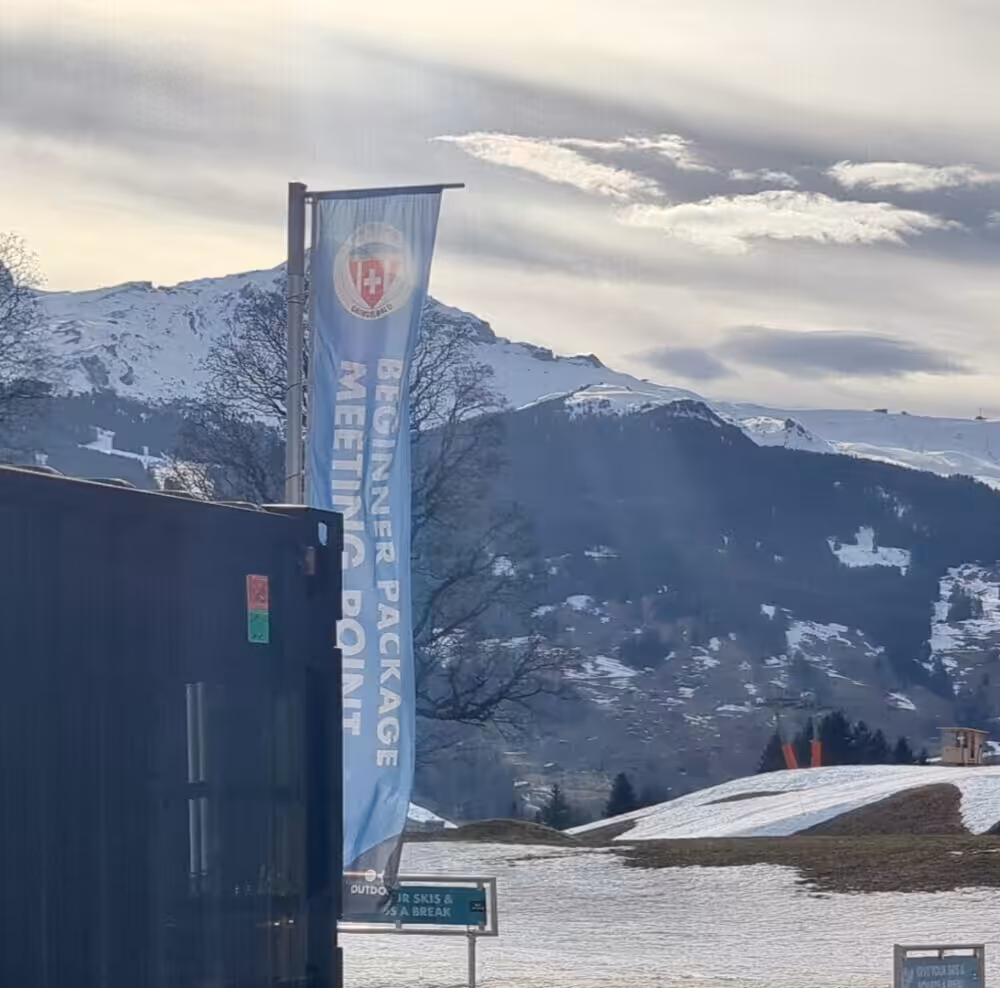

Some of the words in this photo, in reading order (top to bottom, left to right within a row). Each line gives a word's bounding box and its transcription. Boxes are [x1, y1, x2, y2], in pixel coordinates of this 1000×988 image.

[331, 360, 367, 570] MEETING
[371, 358, 403, 564] BEGINNER
[336, 590, 366, 736] POINT
[376, 580, 402, 767] PACKAGE
[400, 906, 409, 916] A
[412, 906, 452, 917] BREAK
[413, 893, 441, 904] SKIS
[444, 894, 453, 904] &
